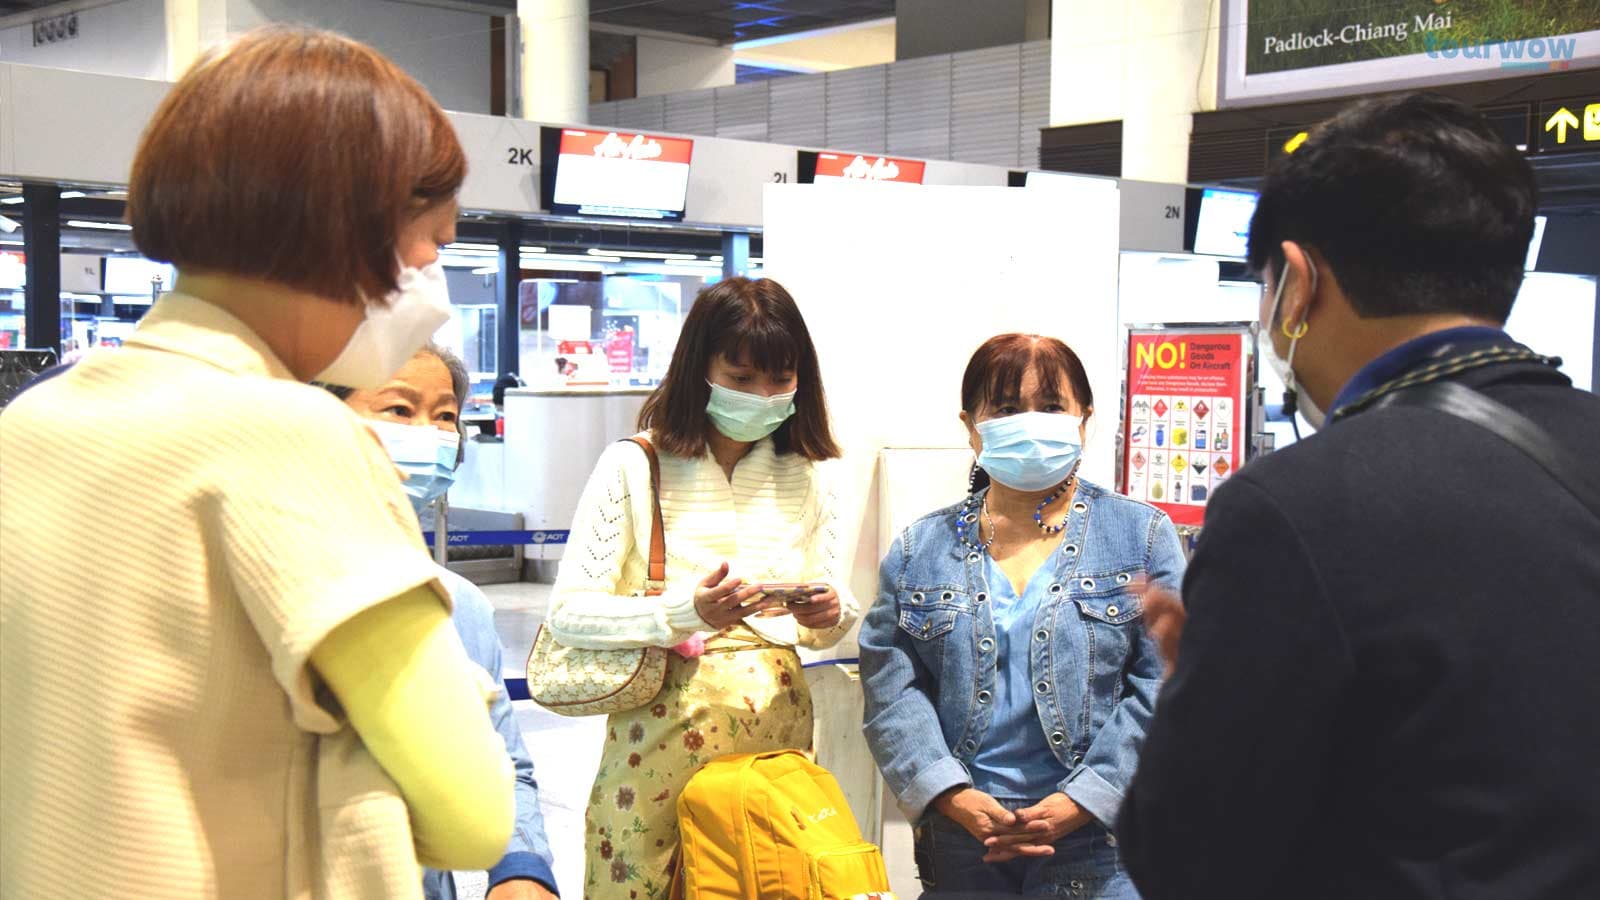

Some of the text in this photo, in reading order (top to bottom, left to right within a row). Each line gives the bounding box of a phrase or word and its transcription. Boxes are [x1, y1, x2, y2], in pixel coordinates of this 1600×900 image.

[1264, 11, 1452, 54] Padlock-Chiang Mai
[508, 147, 533, 165] 2K
[1165, 206, 1180, 219] 2N
[1190, 342, 1231, 351] Dangerous
[1135, 341, 1187, 369] NO!
[1190, 352, 1215, 361] Goods
[1190, 361, 1231, 370] On Aircraft
